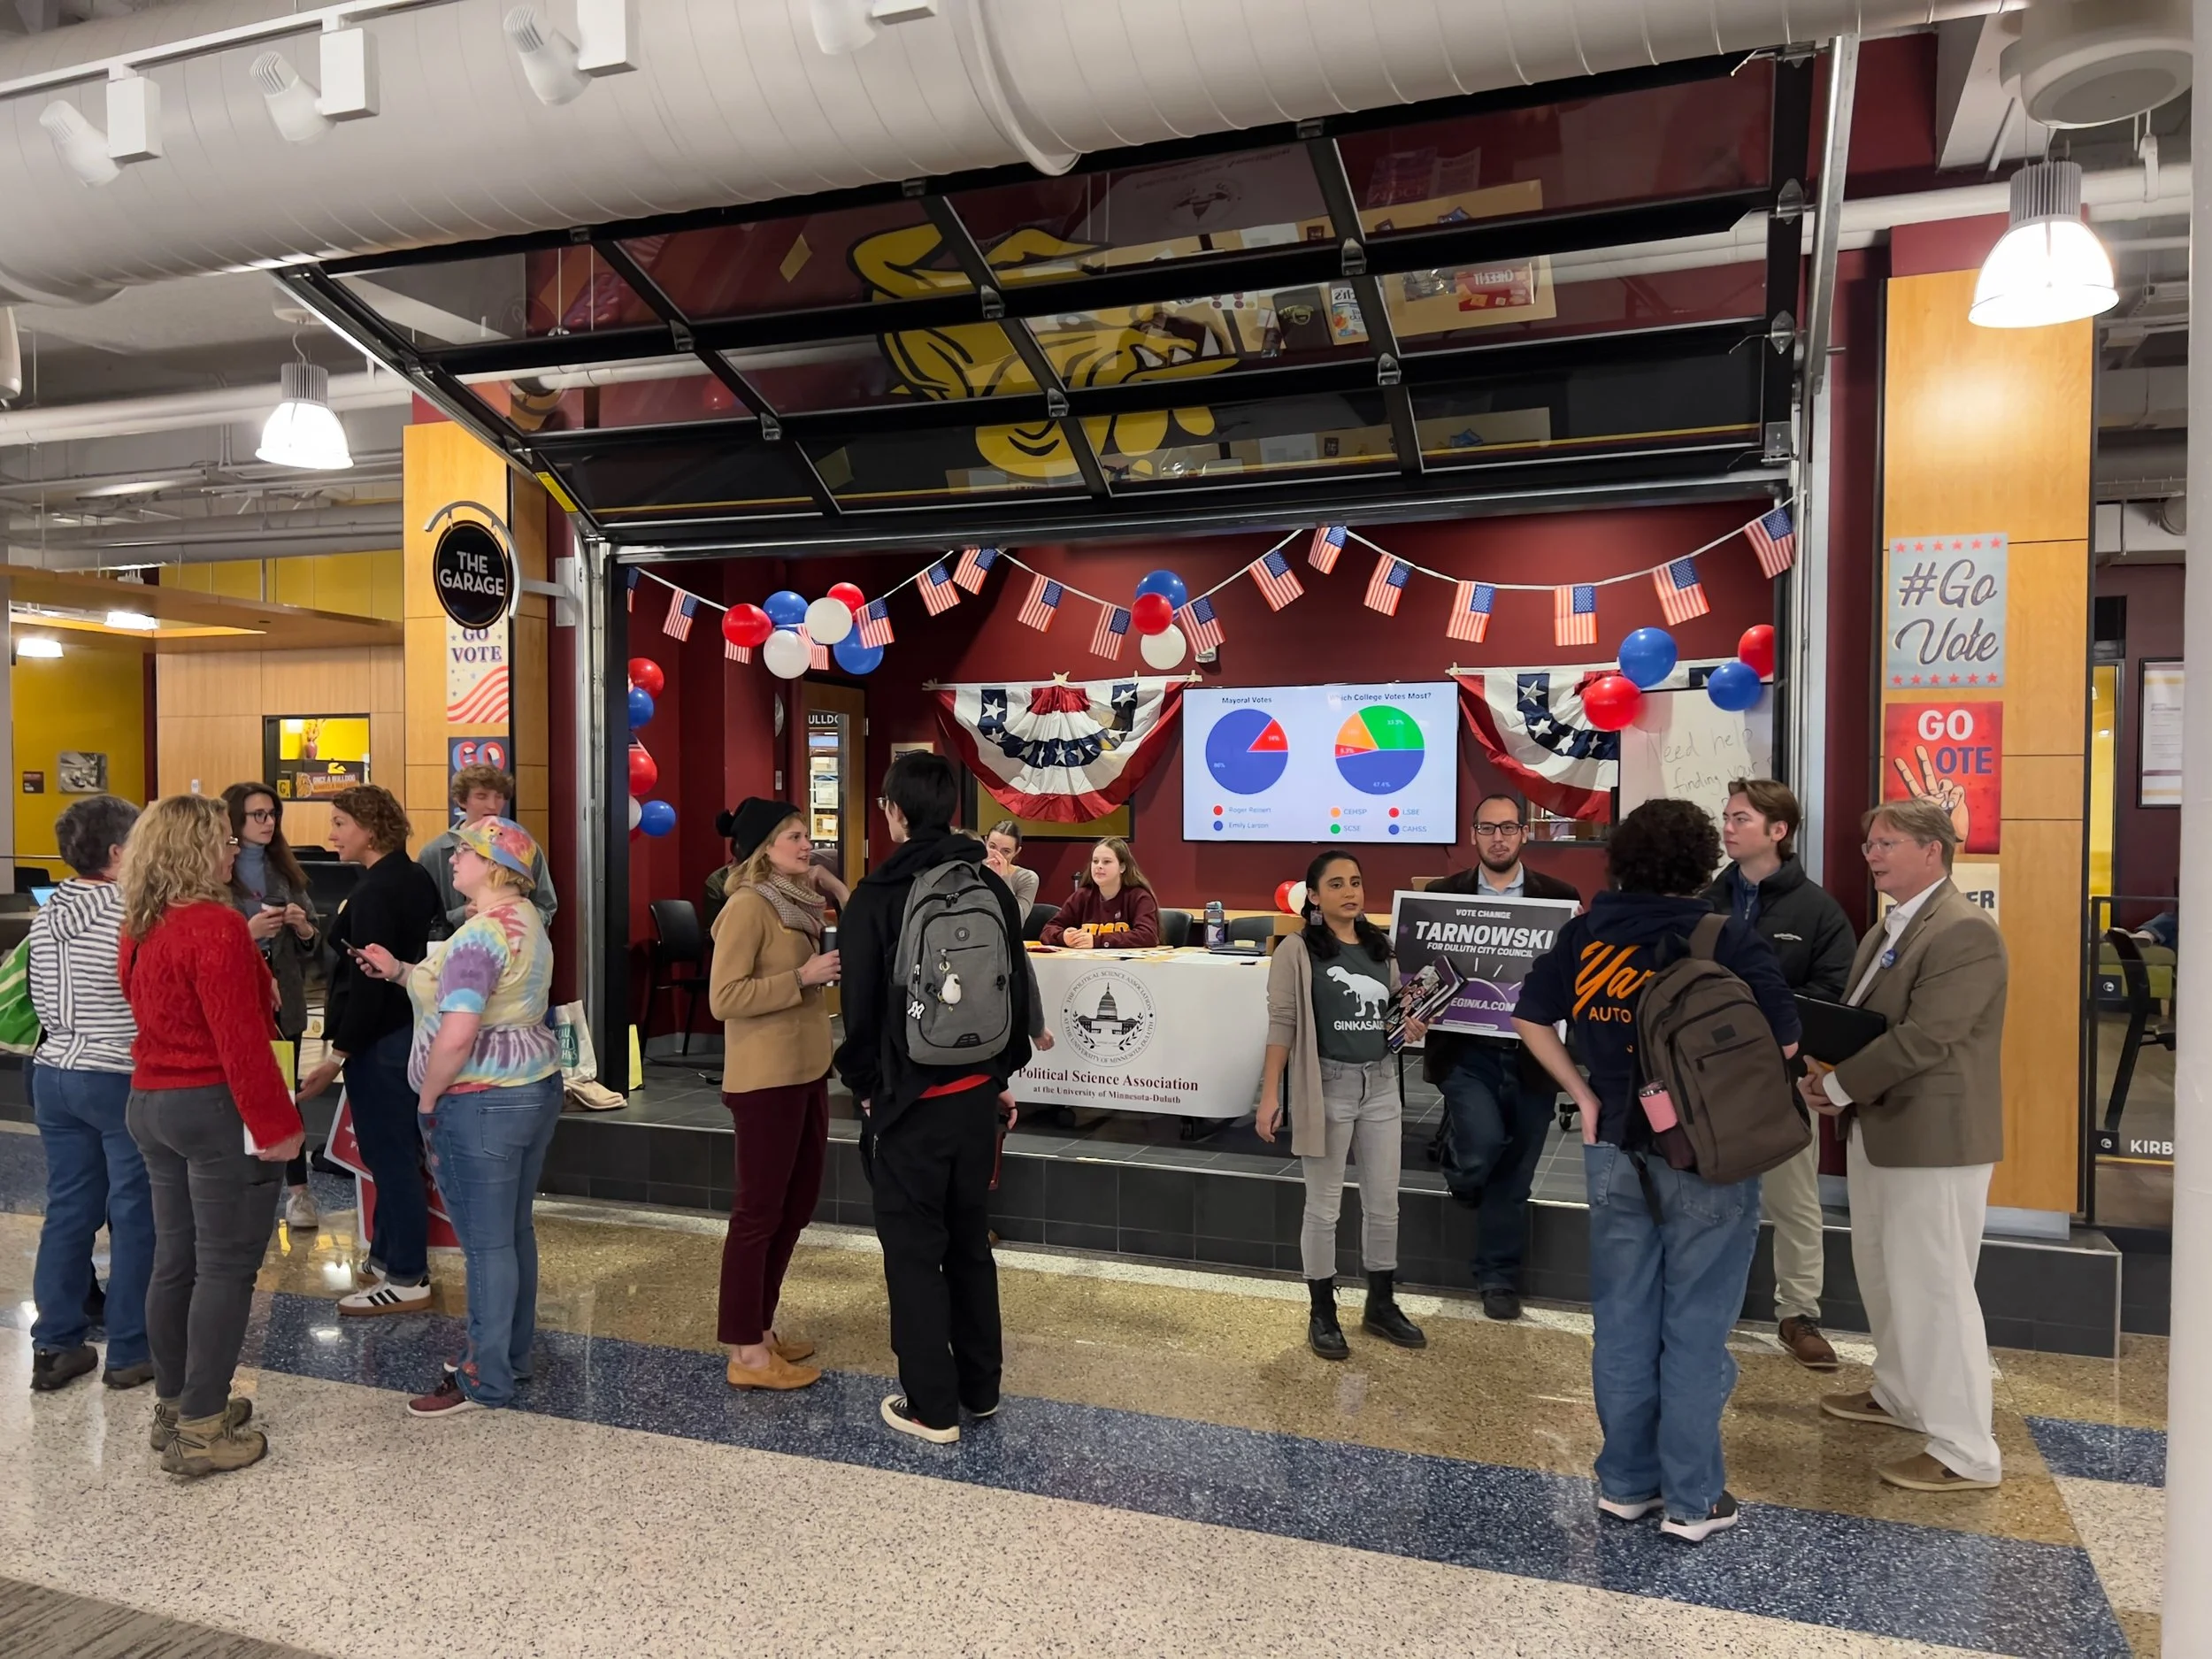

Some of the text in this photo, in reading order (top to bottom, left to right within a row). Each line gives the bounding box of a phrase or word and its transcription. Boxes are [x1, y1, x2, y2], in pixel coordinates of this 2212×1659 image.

[457, 550, 488, 574] THE
[440, 569, 505, 597] GARAGE
[1898, 558, 1998, 609] #Go
[462, 629, 489, 642] GO
[1893, 618, 1999, 665] Vote
[451, 646, 503, 664] VOTE
[1918, 709, 1974, 741] GO
[1646, 719, 1753, 769] Need help
[1673, 767, 1721, 795] finding
[1455, 909, 1511, 919] VOTE CHANGE
[1416, 921, 1554, 949] TARNOWSKI
[1427, 941, 1533, 957] FOR DULUTH CITY COUNCIL
[1101, 971, 1125, 979] SCIENCE
[1588, 1006, 1632, 1023] AUTO
[1018, 1067, 1198, 1091] Political Science Association
[1056, 1087, 1095, 1098] University
[1109, 1091, 1181, 1103] Minnesota-Duluth
[2131, 1139, 2174, 1155] KIRB
